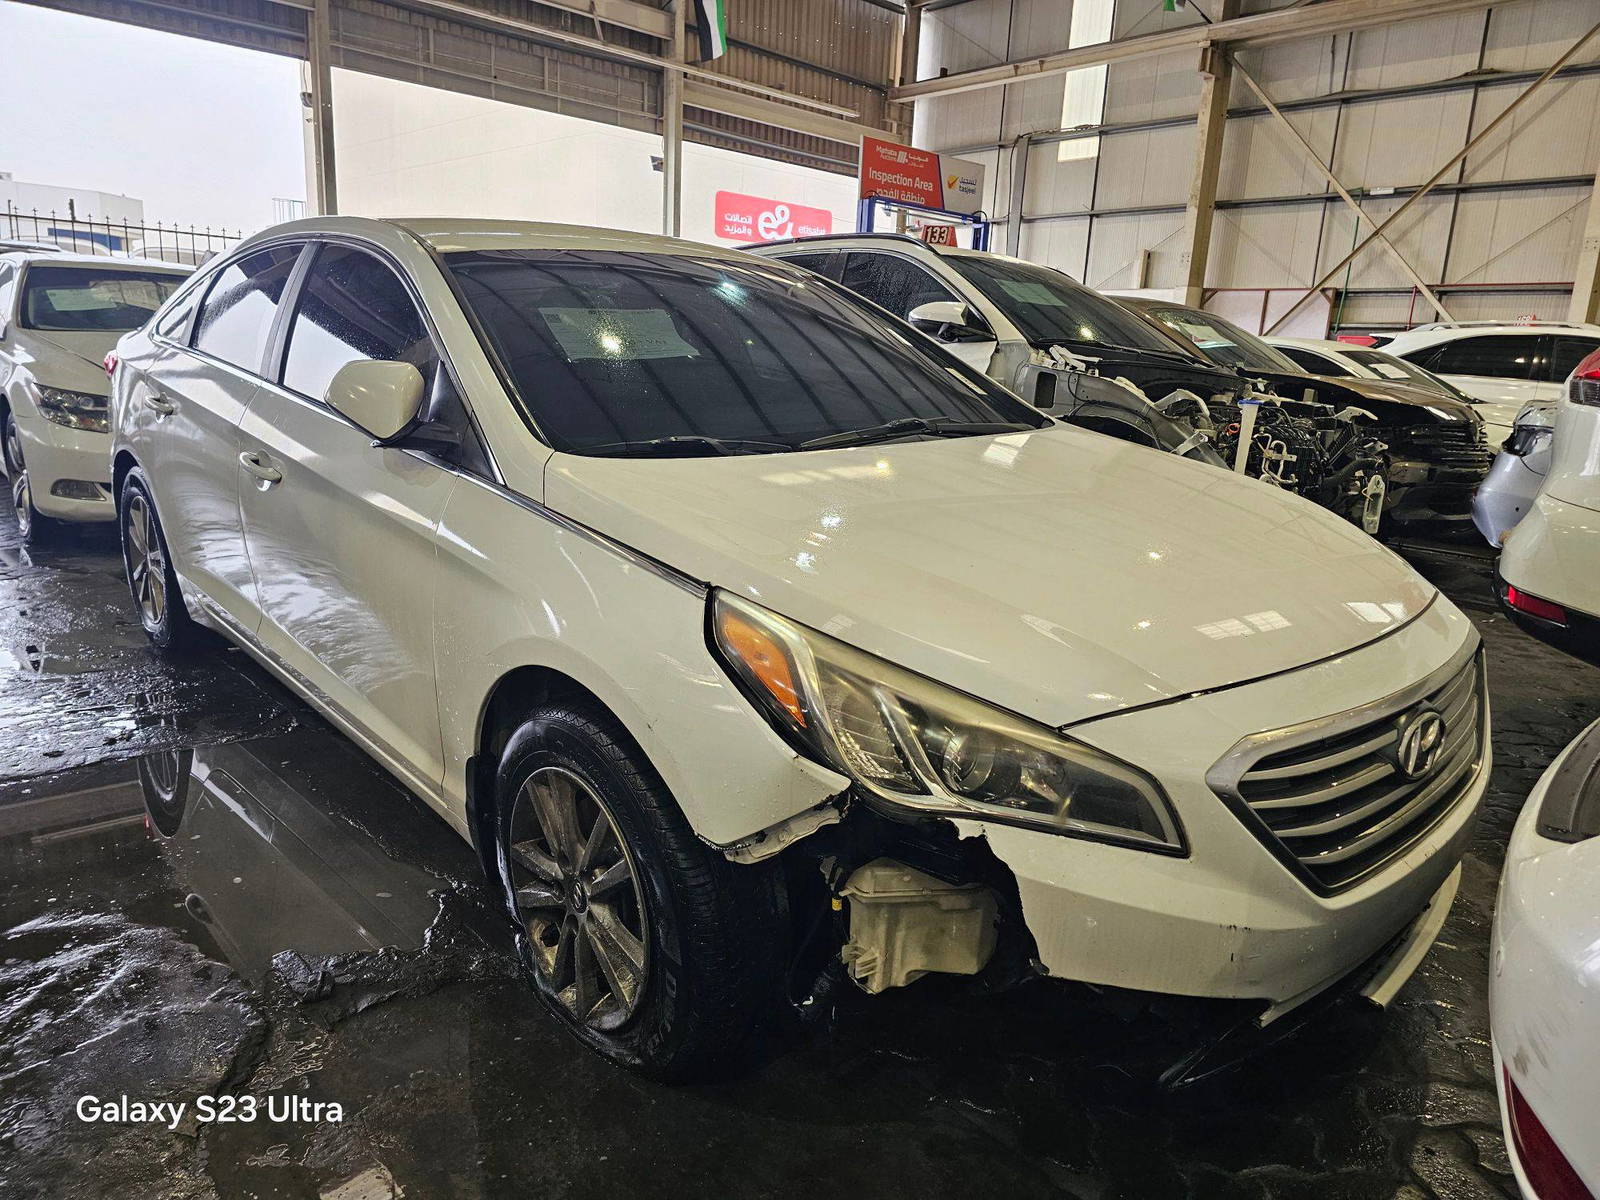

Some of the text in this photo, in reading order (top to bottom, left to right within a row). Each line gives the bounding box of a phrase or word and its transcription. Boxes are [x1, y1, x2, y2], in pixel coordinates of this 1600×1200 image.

[869, 167, 933, 191] Inspection Area
[900, 191, 925, 204] منطقة
[724, 213, 752, 225] اتصالات
[926, 226, 948, 243] 133
